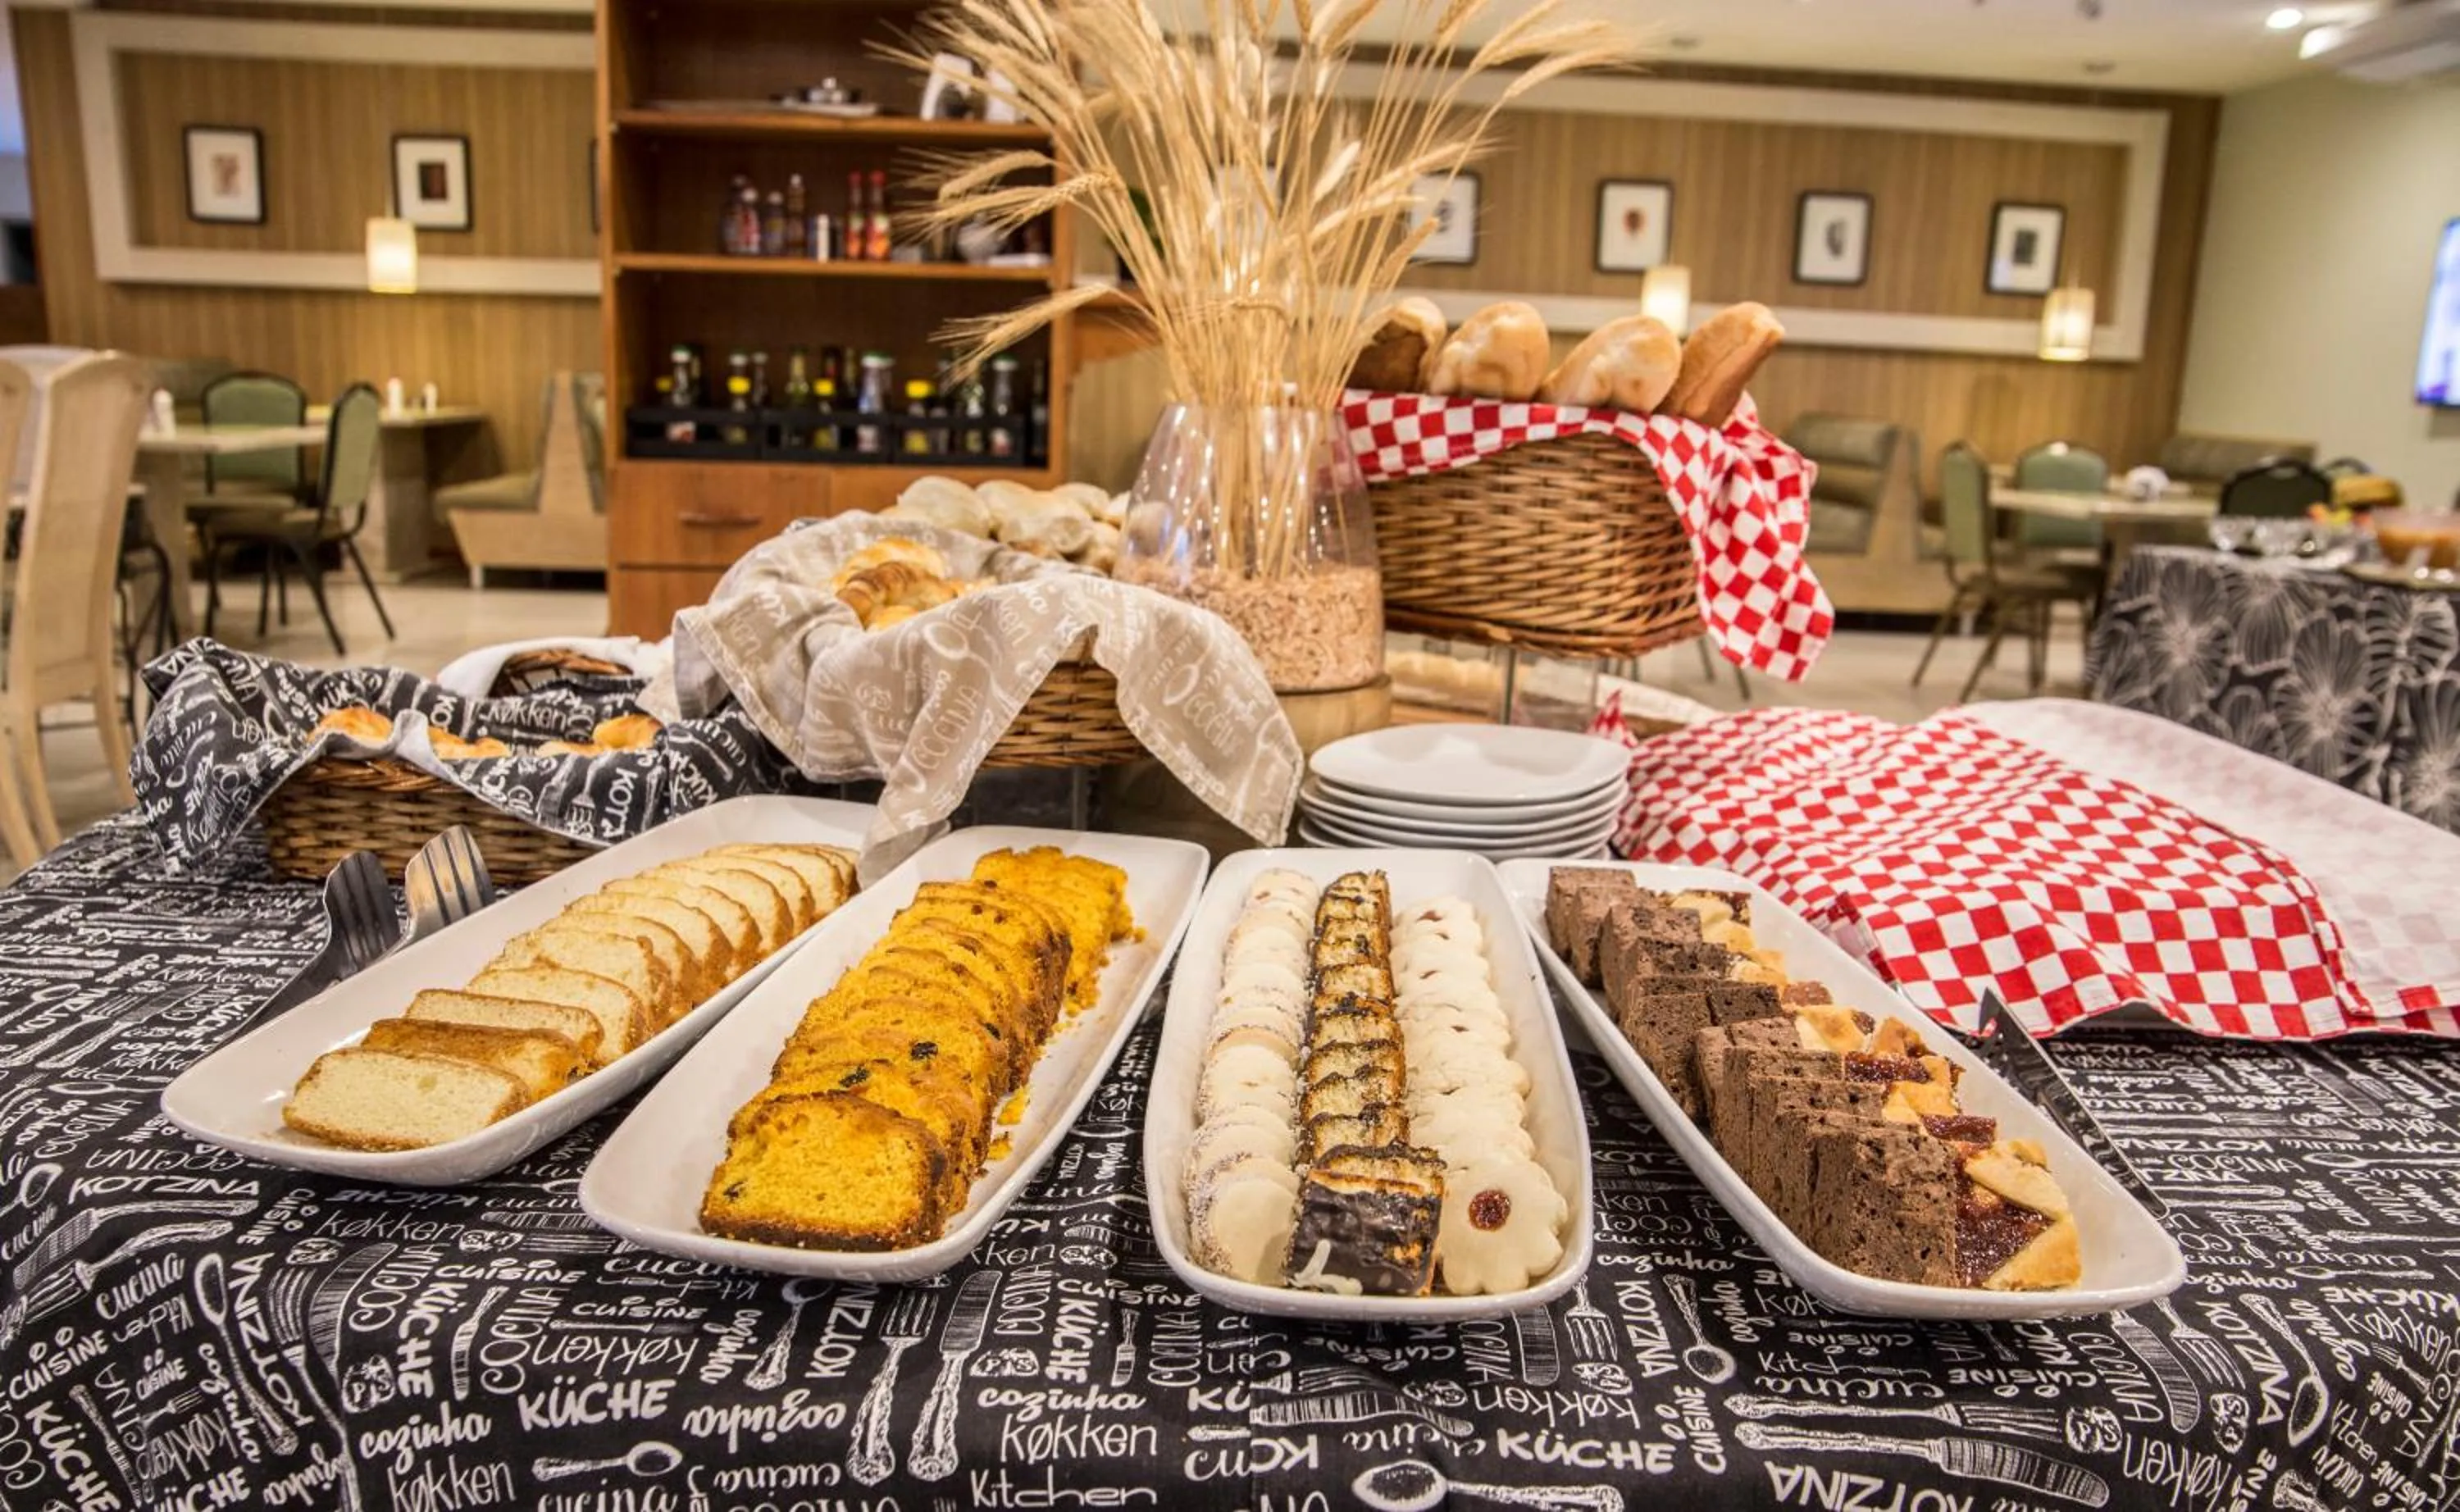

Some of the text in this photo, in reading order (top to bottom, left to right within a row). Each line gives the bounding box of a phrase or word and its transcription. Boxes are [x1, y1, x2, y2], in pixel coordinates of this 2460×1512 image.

[2167, 1153, 2306, 1173] COCINA
[68, 1174, 260, 1205] KOTZINA
[313, 1209, 467, 1241] køkken
[1597, 1250, 1735, 1273] cozinha
[96, 1252, 187, 1321] cucina
[804, 1281, 882, 1378] KOTZIN
[1045, 1297, 1110, 1383] KÜCHE
[532, 1335, 699, 1378] køkken
[517, 1375, 678, 1432] KÜCHE
[977, 1384, 1147, 1423] cozinha
[1473, 1386, 1641, 1430] køkken
[1755, 1376, 1945, 1405] cucina
[358, 1400, 492, 1475] cozinha
[681, 1387, 847, 1455] cozinha
[1000, 1413, 1158, 1465] køkken
[1496, 1428, 1676, 1474] KÜCHE
[388, 1454, 517, 1512] køkken
[713, 1462, 842, 1498] cucina
[970, 1464, 1158, 1509] Kitchen
